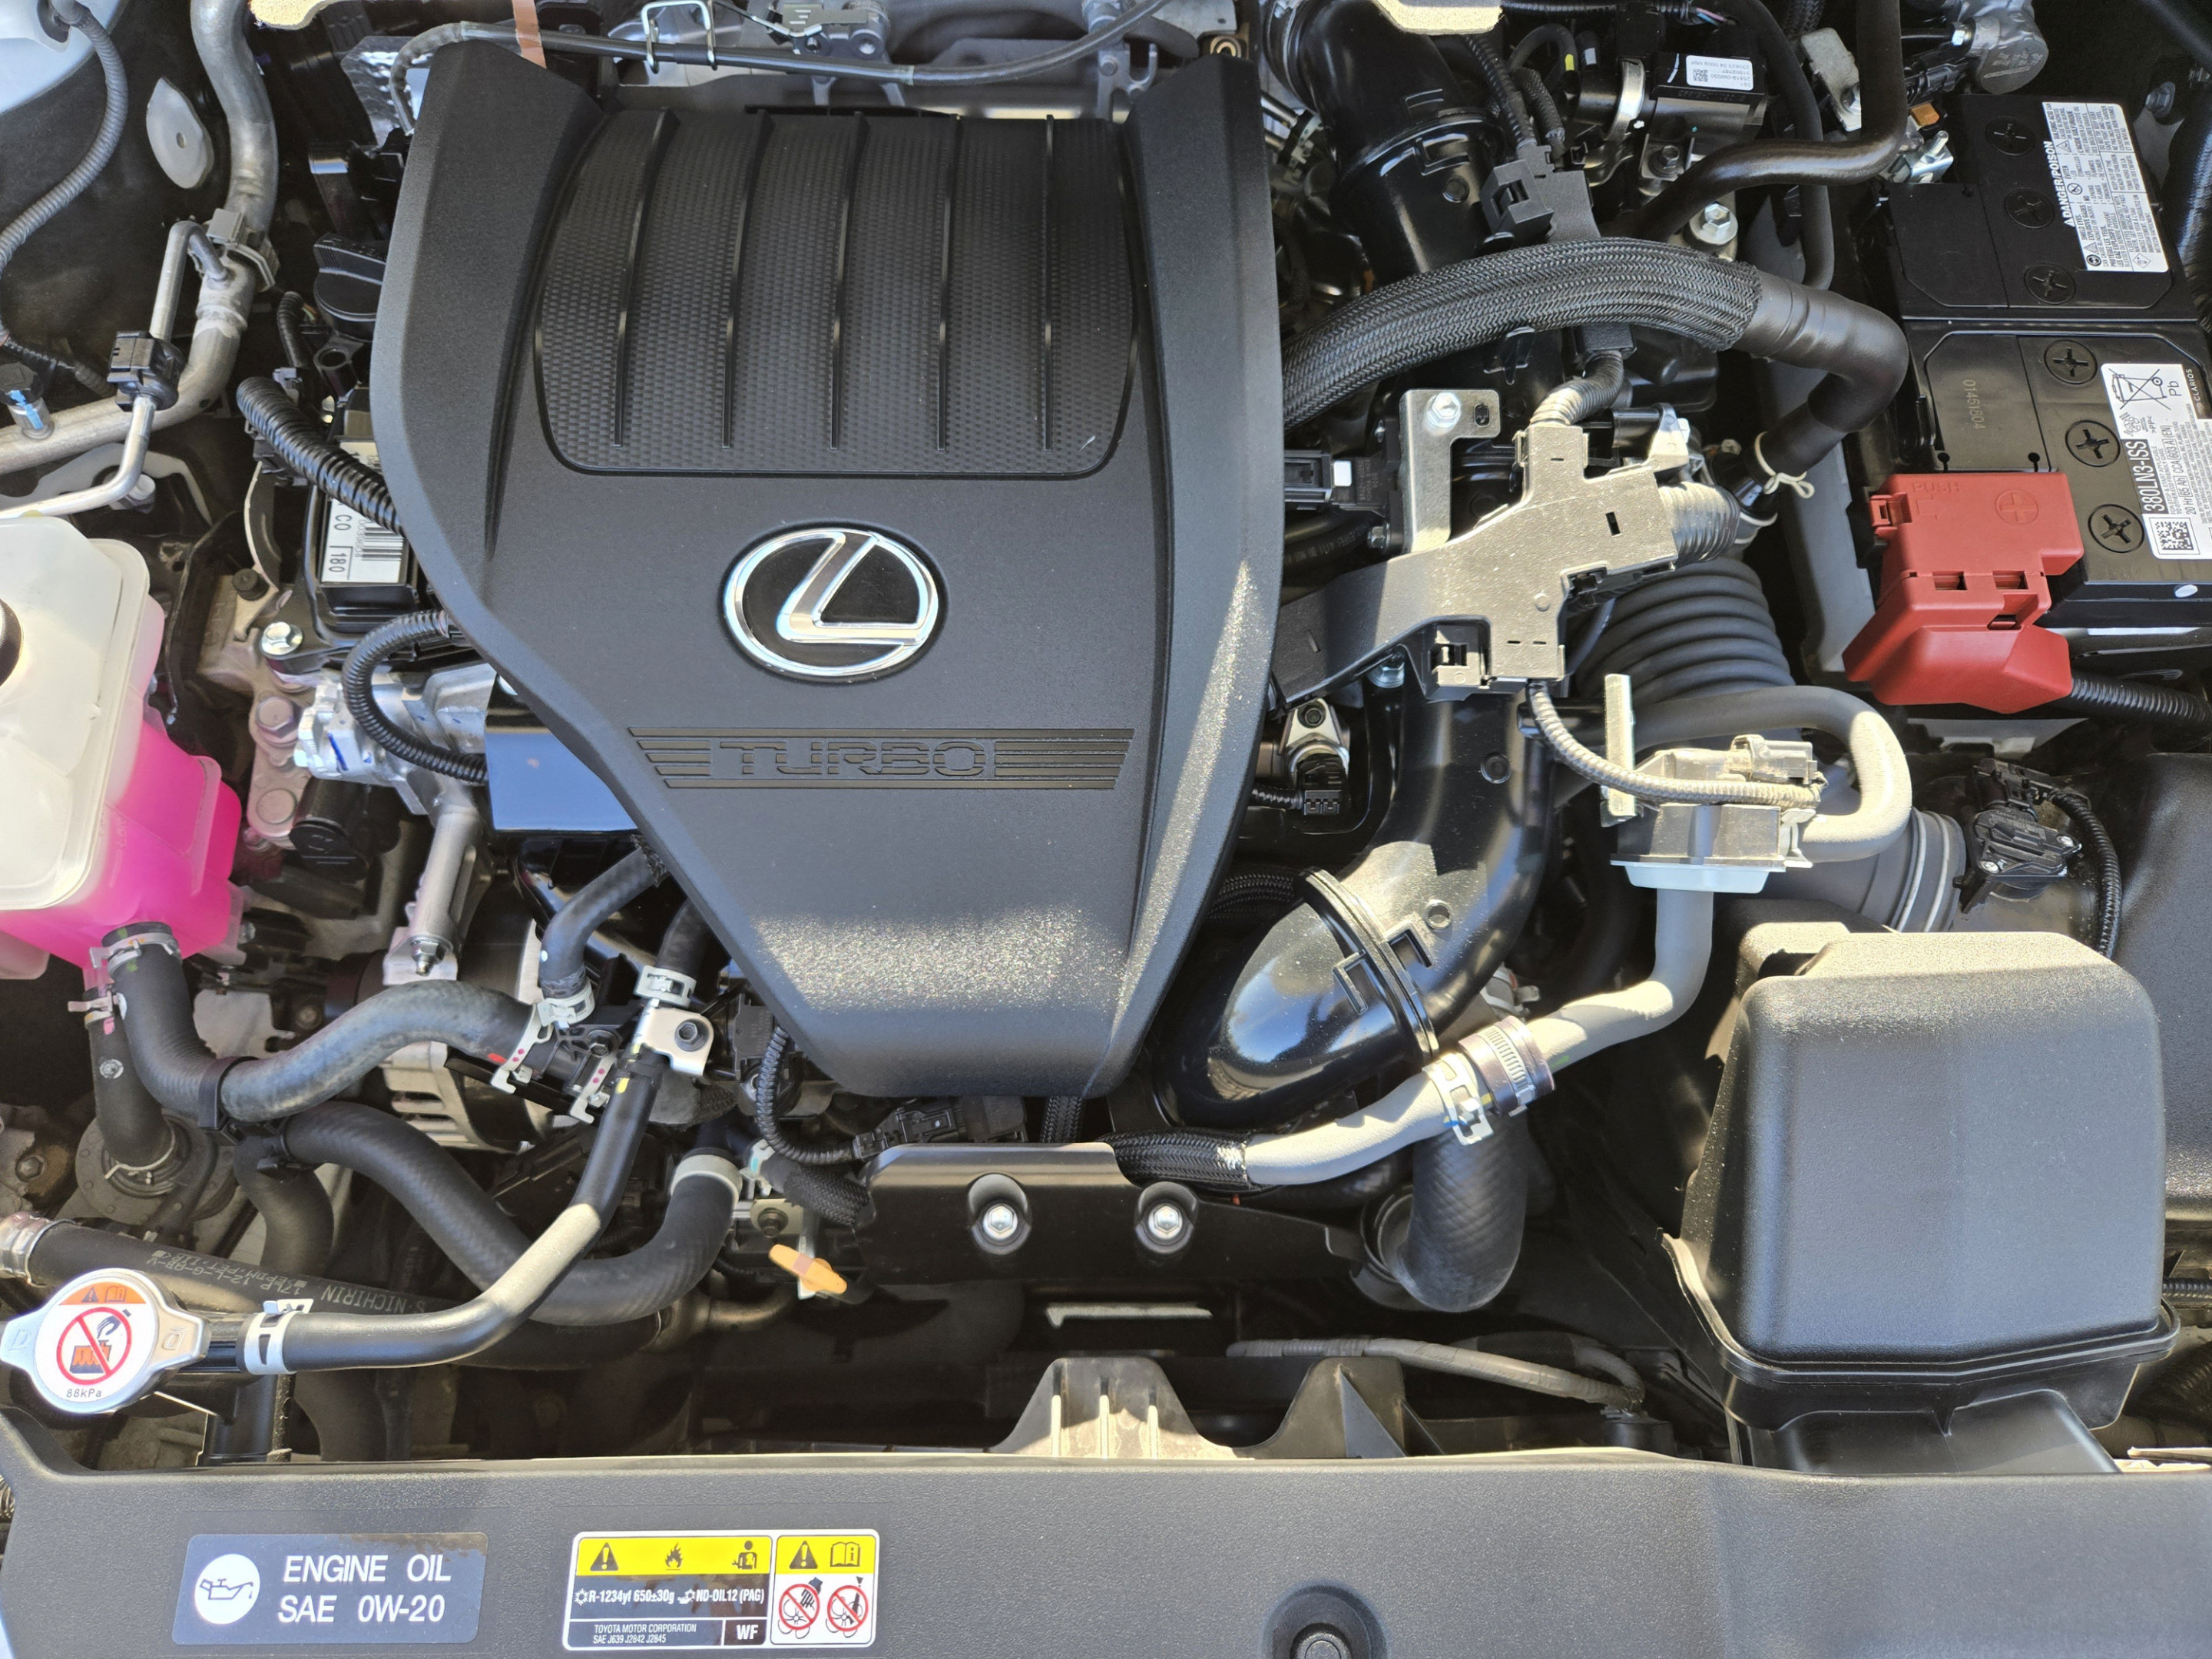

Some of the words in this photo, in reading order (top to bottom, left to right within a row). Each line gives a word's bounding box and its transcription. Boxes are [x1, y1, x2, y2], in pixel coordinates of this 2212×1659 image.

[2042, 141, 2072, 217] DANGER/POISON
[2165, 380, 2181, 396] Pb
[2186, 369, 2200, 401] CLARIOS
[2159, 425, 2174, 437] (EN)
[2165, 446, 2179, 458] 603
[2170, 460, 2184, 473] CCA
[2124, 441, 2165, 511] 380LN3-ISS
[1912, 482, 1960, 493] PUSH
[2178, 487, 2190, 495] 65
[334, 515, 352, 530] CO
[329, 553, 346, 572] 180
[719, 740, 985, 777] TURBO
[66, 1387, 102, 1399] 88kPa
[283, 1554, 388, 1584] ENGINE
[407, 1554, 452, 1584] OIL
[588, 1589, 632, 1604] R-1234yf
[634, 1590, 674, 1604] 650±30g
[696, 1588, 738, 1602] ND-OIL12
[740, 1588, 764, 1604] (PAG)
[277, 1594, 336, 1624] SAE
[358, 1594, 445, 1624] 0W-20
[594, 1624, 621, 1634] TOYOTA
[621, 1624, 647, 1634] MOTOR
[648, 1624, 697, 1634] CORPORATION
[737, 1625, 758, 1641] WF
[593, 1634, 607, 1644] SAE
[608, 1634, 624, 1644] J639
[625, 1634, 645, 1644] J2842
[647, 1634, 666, 1644] J2845
